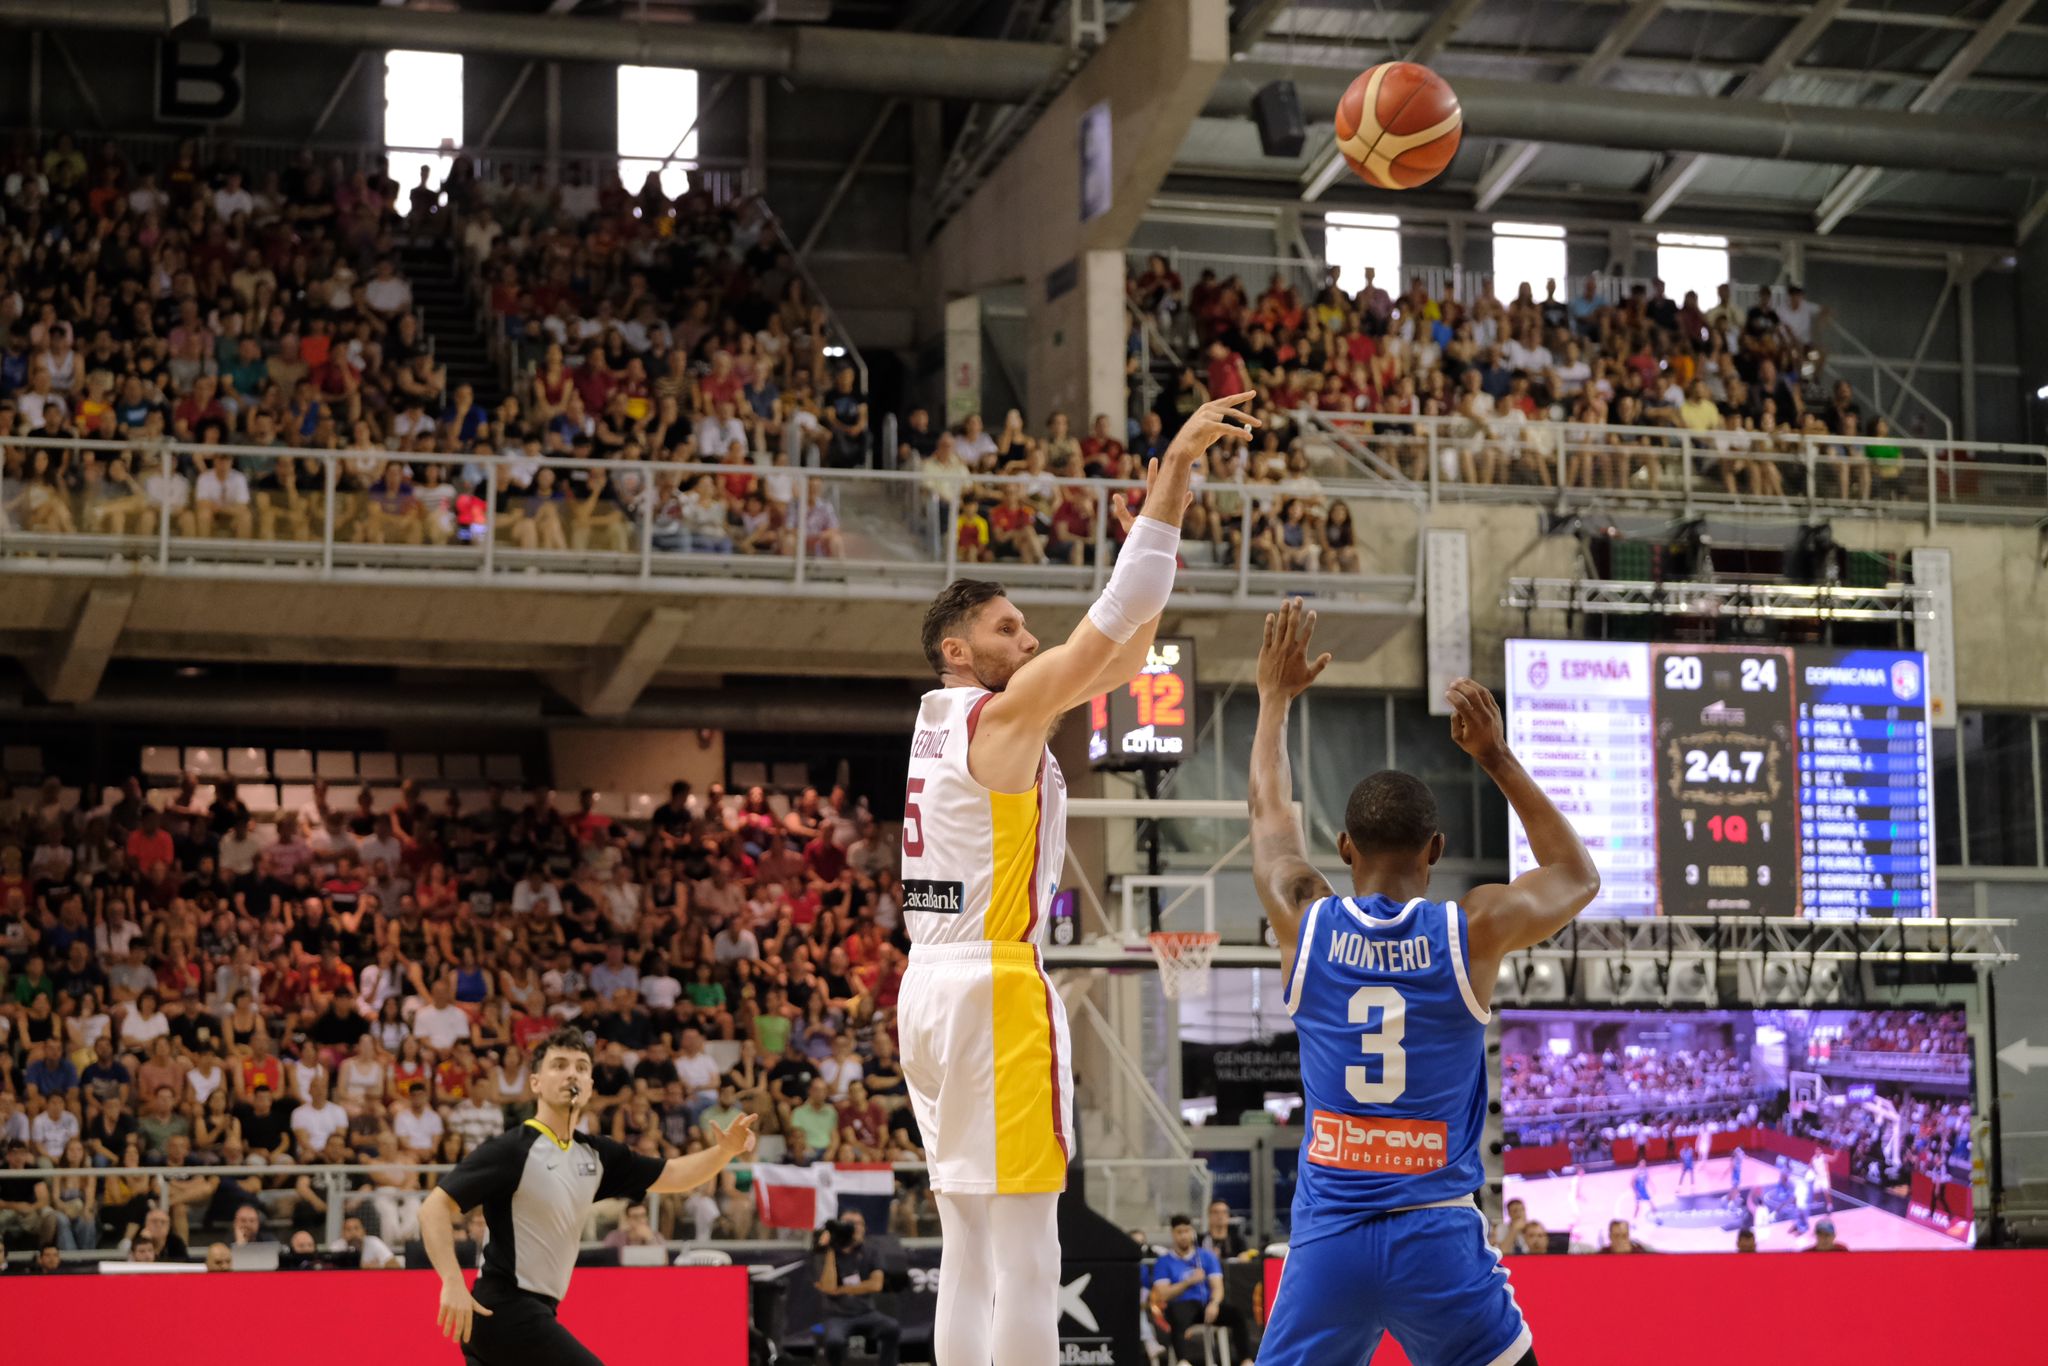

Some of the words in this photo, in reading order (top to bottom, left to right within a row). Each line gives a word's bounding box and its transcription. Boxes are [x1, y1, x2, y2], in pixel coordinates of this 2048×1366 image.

[160, 33, 241, 118] B
[1561, 657, 1631, 680] ESPAÑA
[1664, 656, 1702, 690] 20
[1740, 658, 1777, 692] 24
[1805, 666, 1887, 687] DOMINICANA
[1129, 672, 1185, 726] 12
[1685, 750, 1764, 783] 24.7
[903, 778, 925, 857] 5
[1684, 820, 1694, 842] 1
[1707, 815, 1748, 844] 1Q
[1761, 822, 1771, 842] 1
[1685, 864, 1699, 886] 3
[1757, 865, 1771, 887] 3
[1327, 930, 1432, 972] MONTERO
[1345, 986, 1406, 1104] 3
[1346, 1120, 1443, 1151] brava
[1343, 1149, 1447, 1169] lubricants
